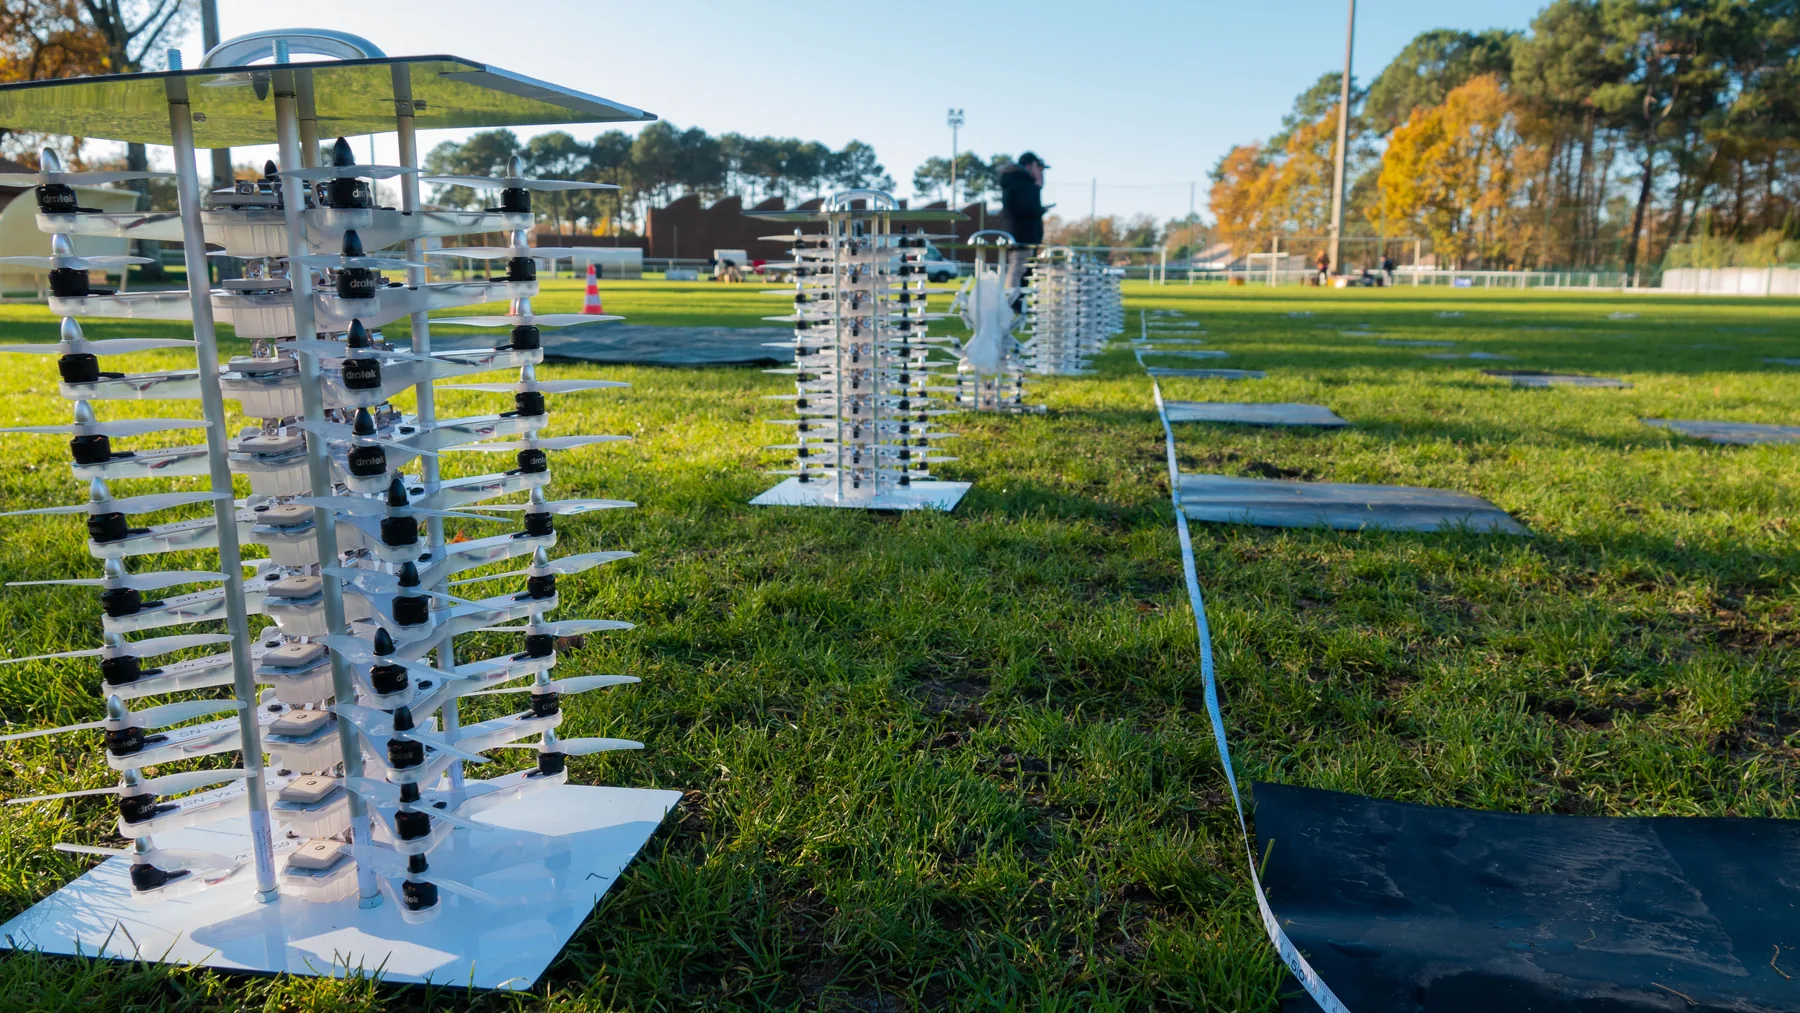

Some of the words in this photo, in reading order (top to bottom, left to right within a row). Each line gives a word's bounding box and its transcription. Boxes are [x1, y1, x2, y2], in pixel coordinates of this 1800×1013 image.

[42, 193, 75, 204] drotek
[346, 369, 377, 379] drotek
[356, 455, 385, 466] drotek
[1291, 960, 1305, 982] 50
